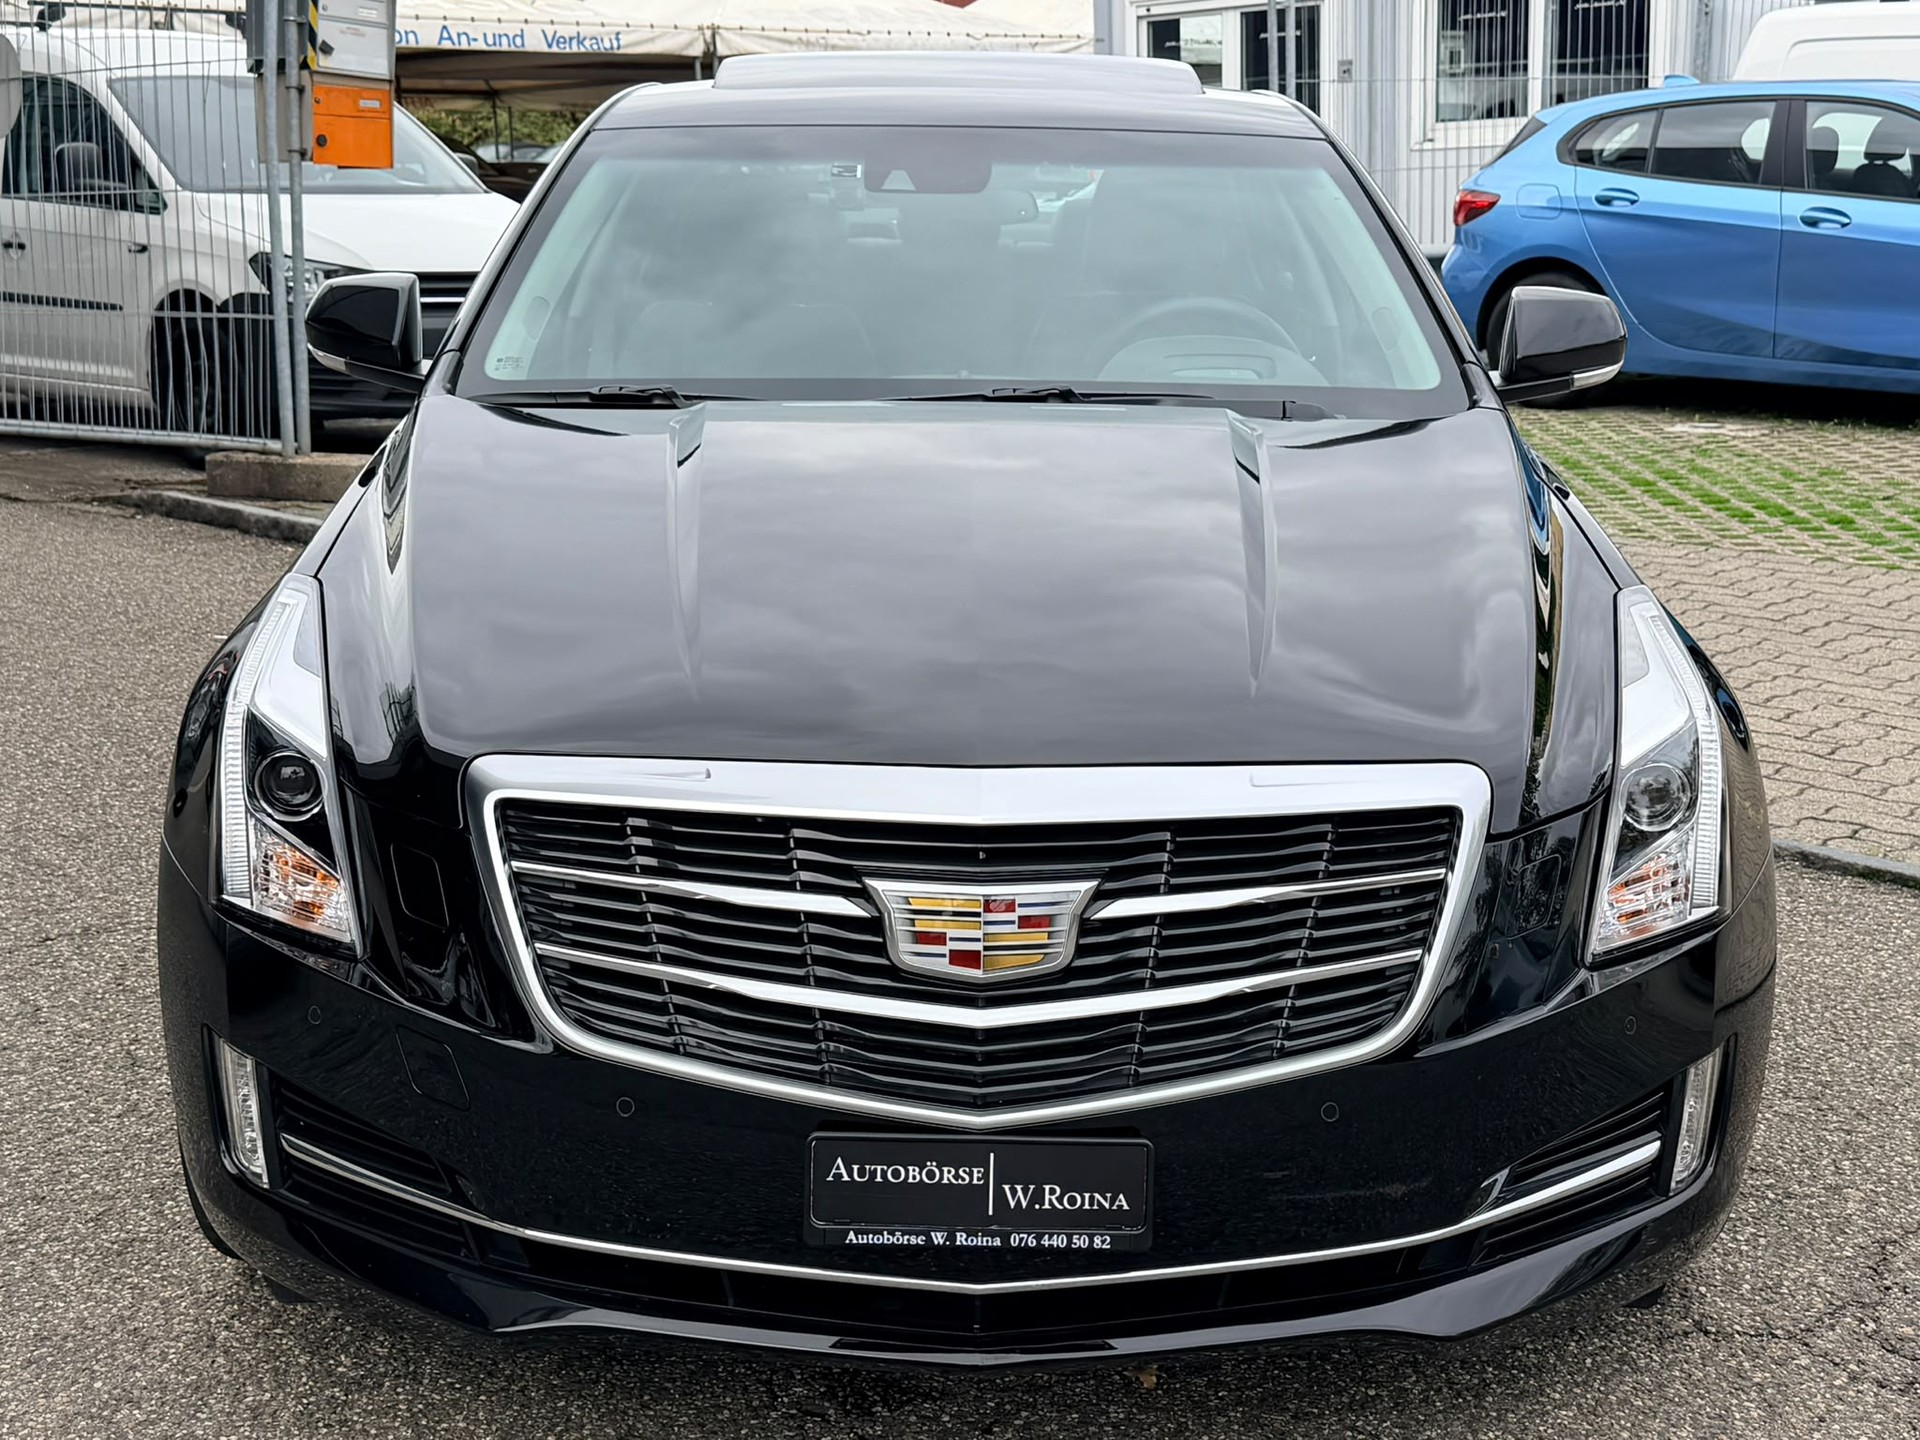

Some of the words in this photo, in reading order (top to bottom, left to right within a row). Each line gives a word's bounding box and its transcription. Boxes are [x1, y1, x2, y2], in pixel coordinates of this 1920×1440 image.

[541, 28, 622, 51] Verkauf
[845, 1231, 926, 1246] Autobörse
[930, 1233, 950, 1245] W.
[955, 1233, 1001, 1246] Roina
[1010, 1233, 1037, 1247] 076
[1041, 1234, 1067, 1248] 440
[1071, 1234, 1089, 1249] 50
[1093, 1235, 1111, 1249] 82
